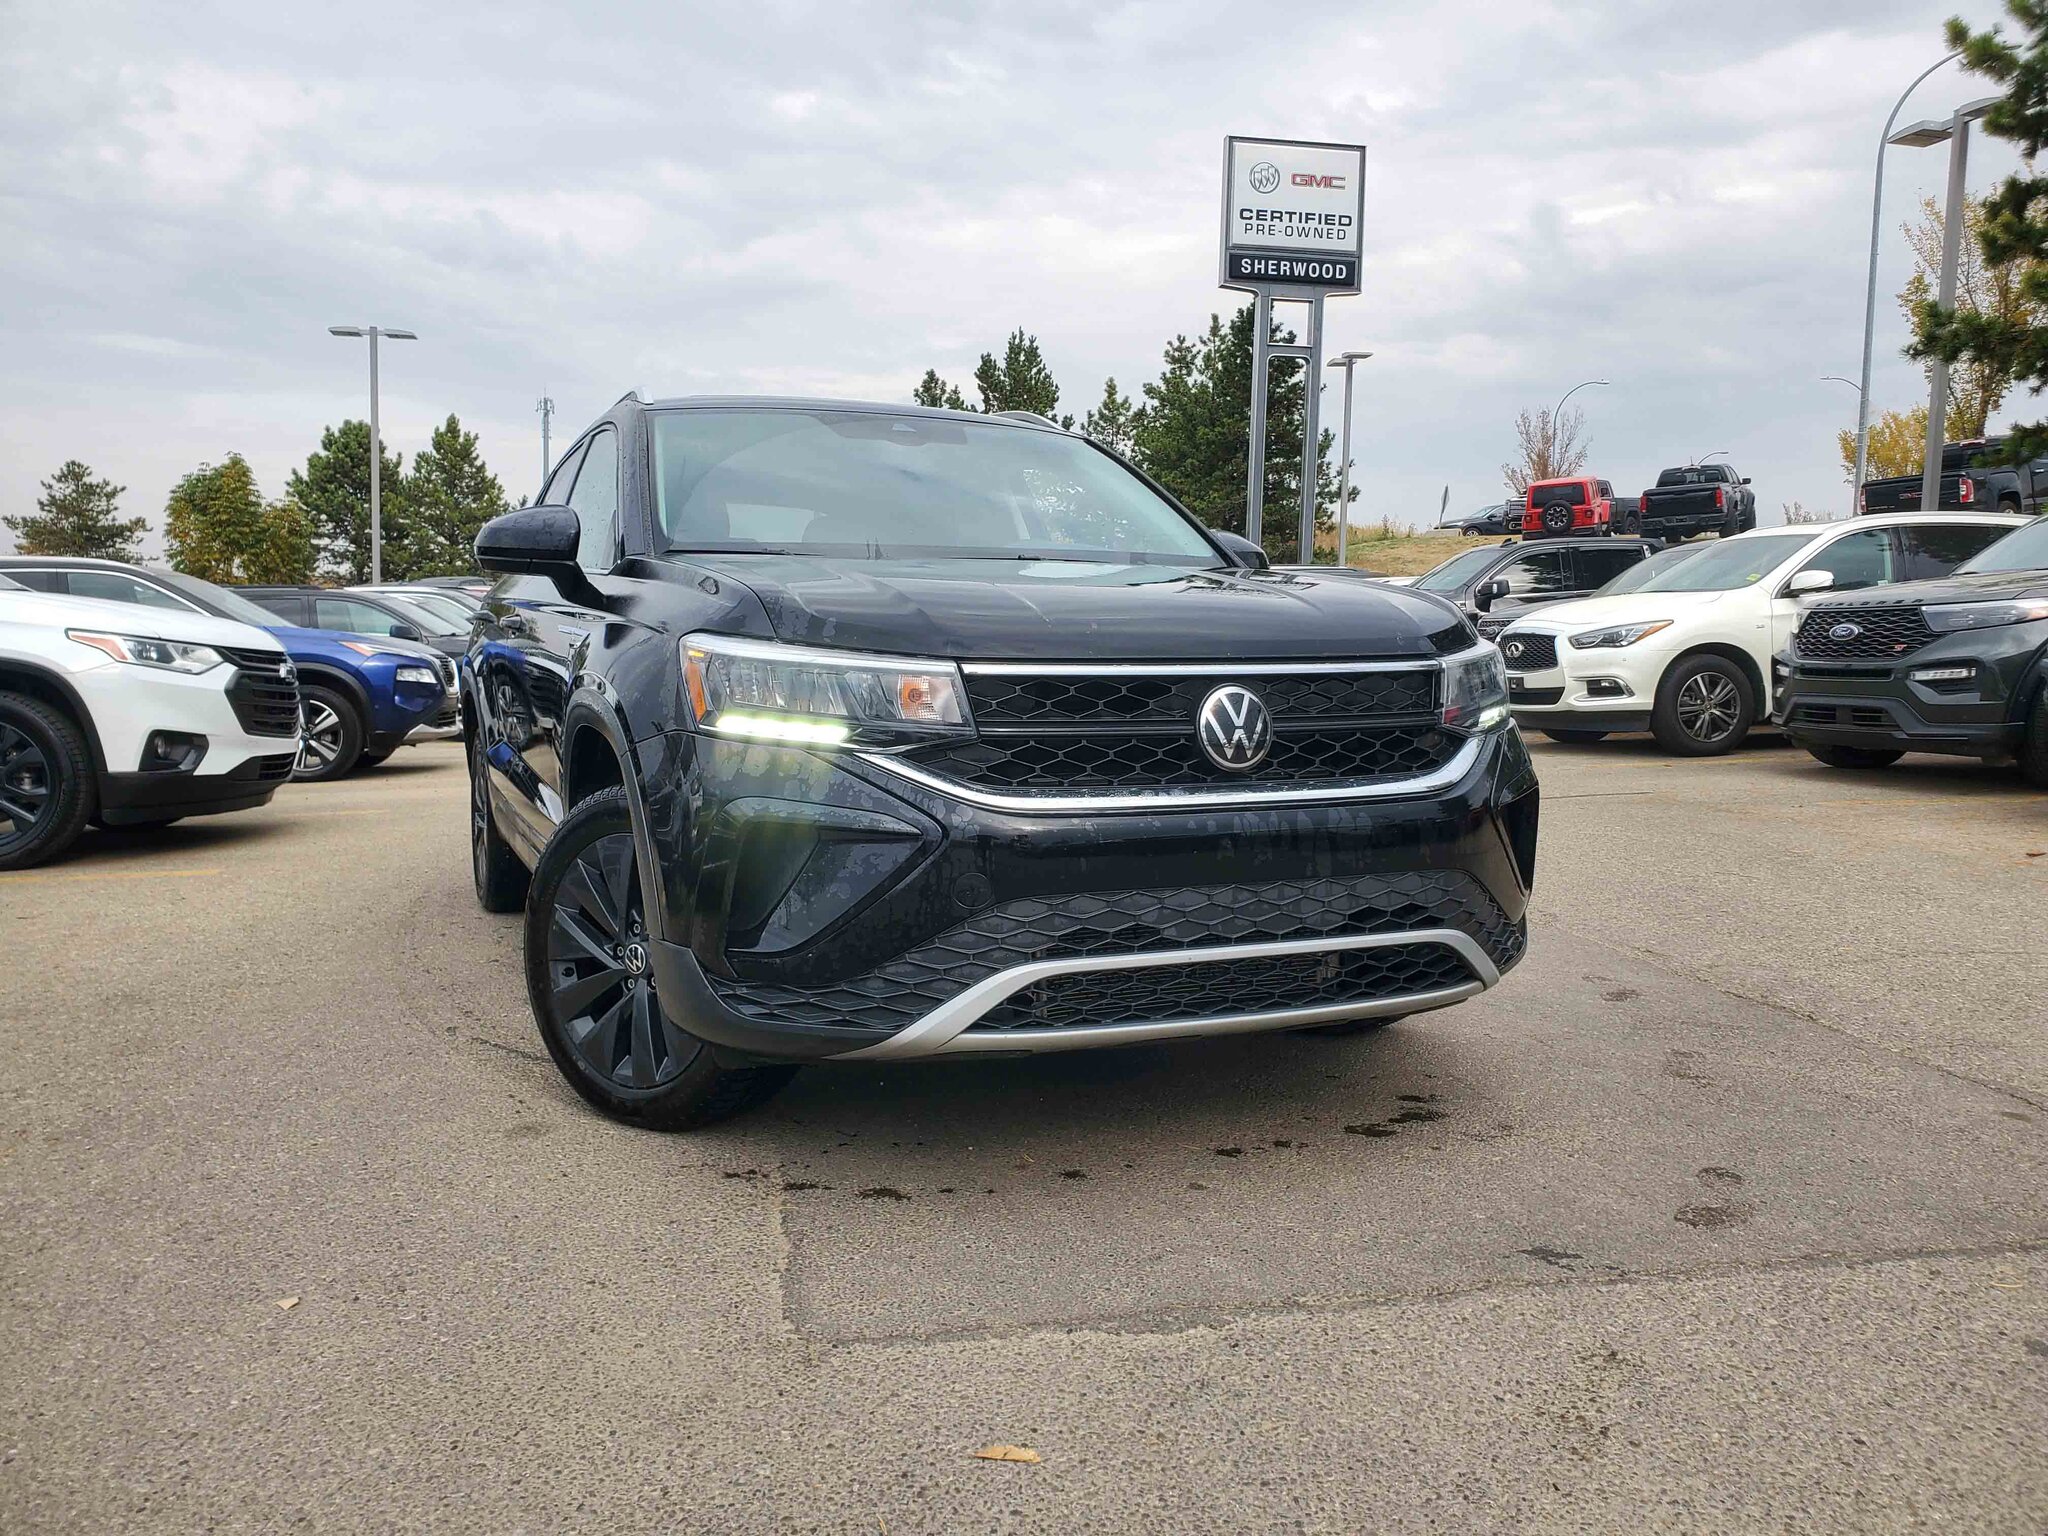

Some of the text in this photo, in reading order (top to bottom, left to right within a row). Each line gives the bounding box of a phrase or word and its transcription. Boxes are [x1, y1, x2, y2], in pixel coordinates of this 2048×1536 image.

[1291, 173, 1346, 190] GMC
[1239, 208, 1353, 227] CERTIFIED
[1244, 223, 1347, 240] PRE-OWNED
[1240, 258, 1347, 279] SHERWOOD
